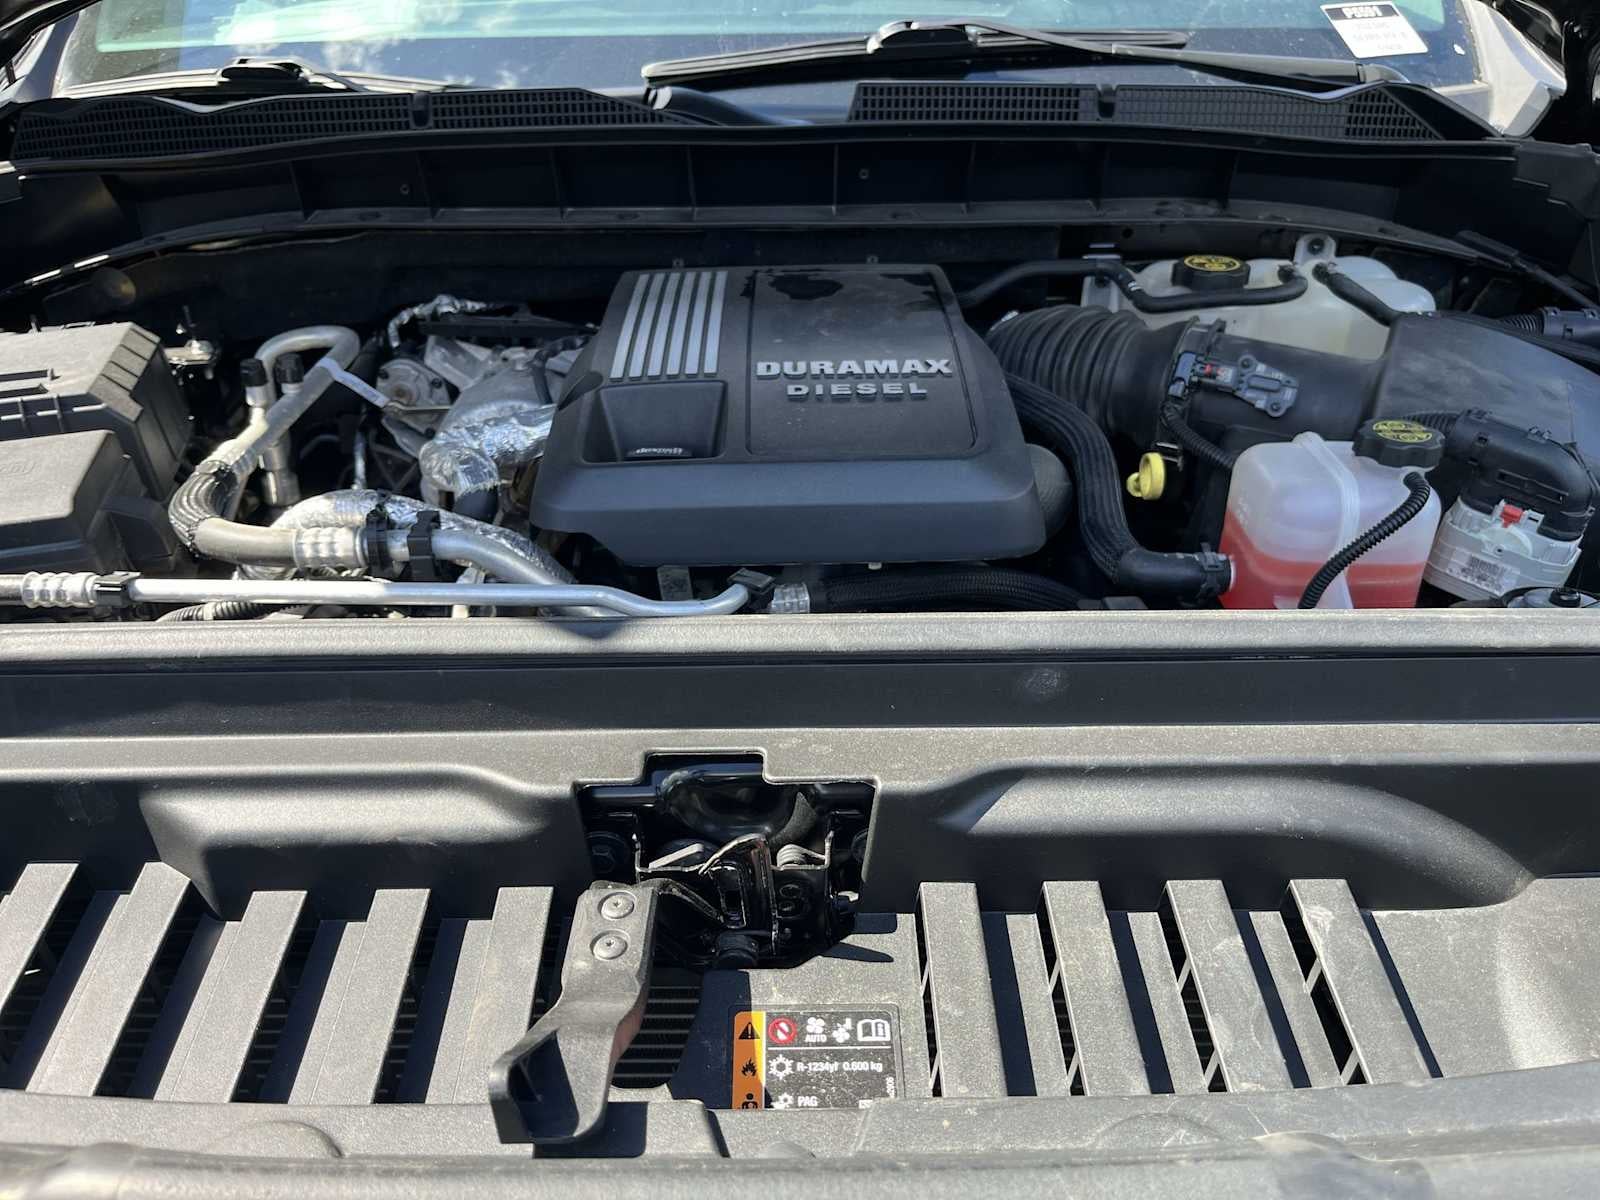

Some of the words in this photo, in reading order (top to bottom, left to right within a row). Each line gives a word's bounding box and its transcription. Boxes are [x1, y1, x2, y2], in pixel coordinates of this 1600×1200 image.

[756, 359, 952, 378] DURAMAX
[787, 383, 928, 398] DIESEL
[804, 1033, 828, 1043] AUTO
[796, 1061, 839, 1073] R-1234yf
[842, 1061, 869, 1072] 0.600
[870, 1061, 883, 1072] kg
[797, 1096, 818, 1107] PAG
